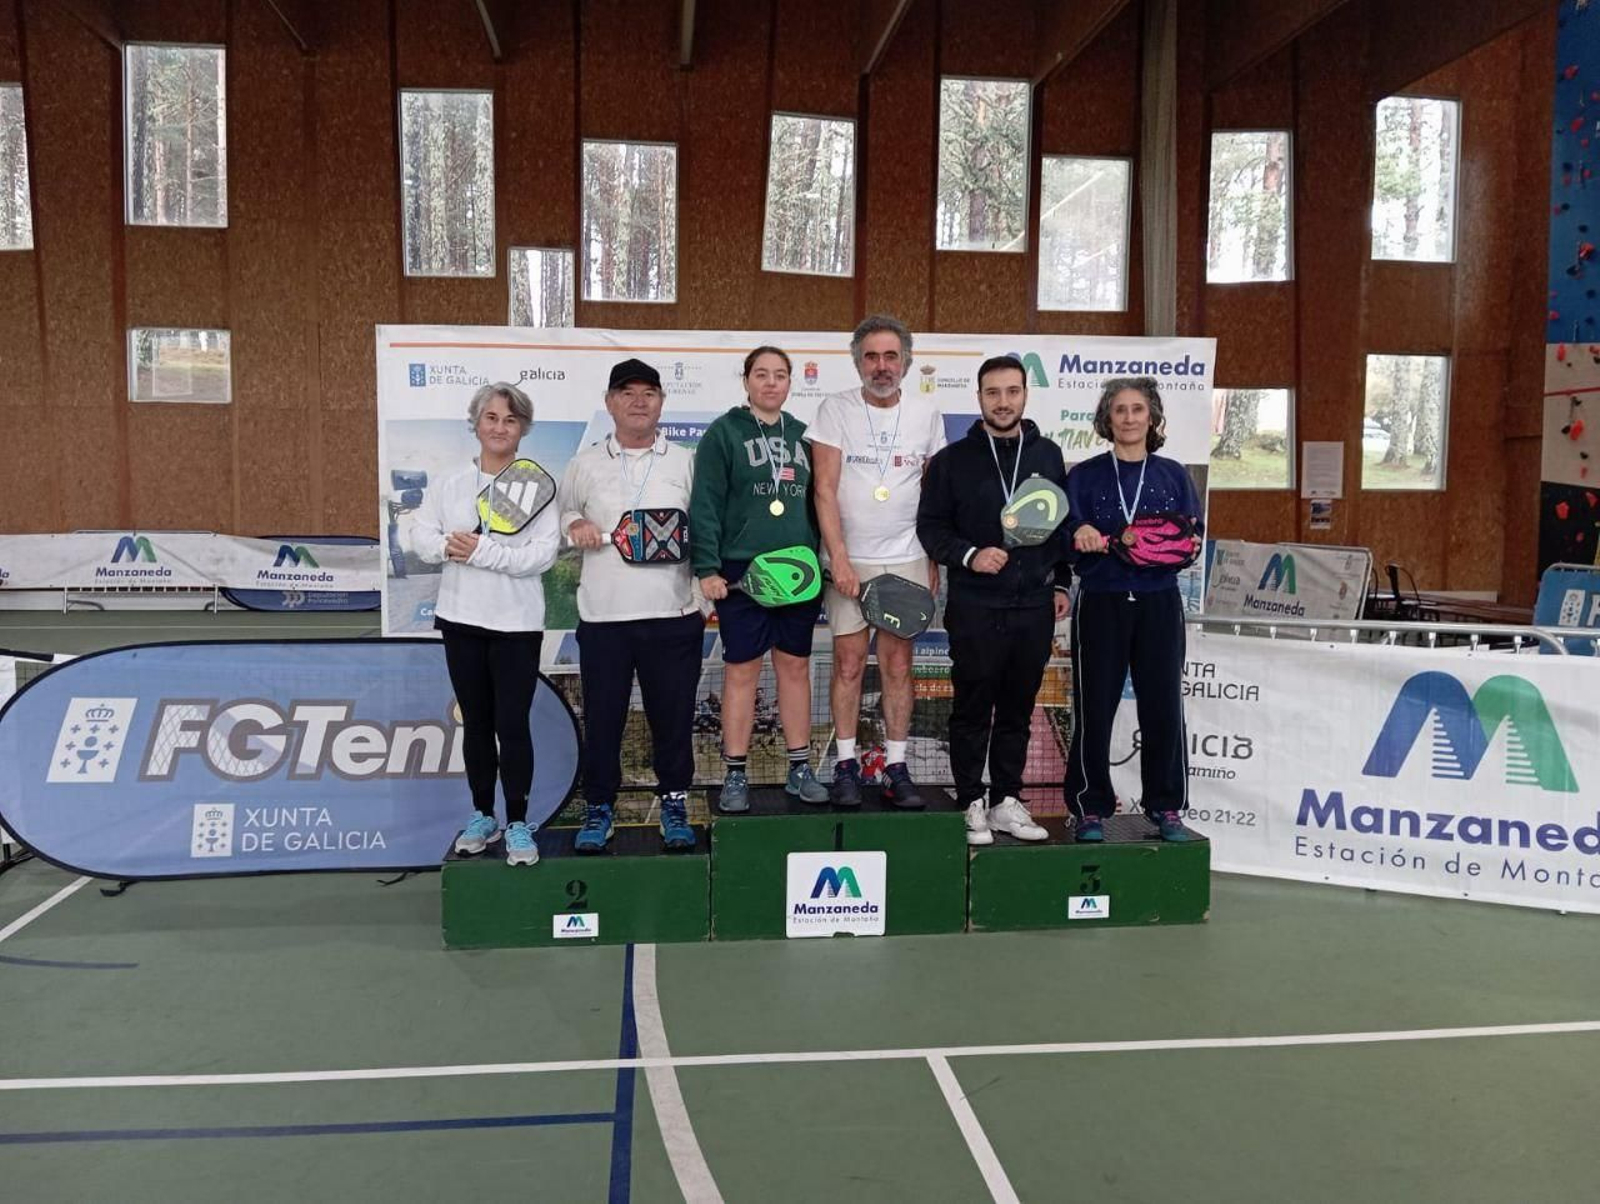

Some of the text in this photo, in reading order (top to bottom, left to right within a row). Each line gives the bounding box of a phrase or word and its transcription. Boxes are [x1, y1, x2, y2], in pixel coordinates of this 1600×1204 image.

[429, 365, 467, 375] XUNTA
[1059, 354, 1205, 376] Manzaneda
[429, 375, 490, 386] DE GALICIA
[519, 367, 566, 381] galicia
[1057, 378, 1205, 391] Estaci ontaña
[1060, 410, 1095, 421] Par
[689, 427, 707, 438] Pa
[743, 436, 811, 473] USA
[95, 566, 172, 577] Manzaneda
[256, 569, 335, 582] Manzaneda
[1243, 593, 1306, 617] Manzaneda
[1182, 661, 1217, 678] NTA
[139, 698, 467, 782] FGTeni
[1187, 765, 1237, 780] amiño
[243, 807, 333, 828] XUNTA
[1296, 788, 1600, 855] Manzaned
[241, 831, 388, 852] DE GALICIA
[1295, 835, 1600, 889] Estación de Monta
[1080, 864, 1101, 894] 3
[565, 879, 588, 910] 2
[793, 901, 880, 915] Manzaneda
